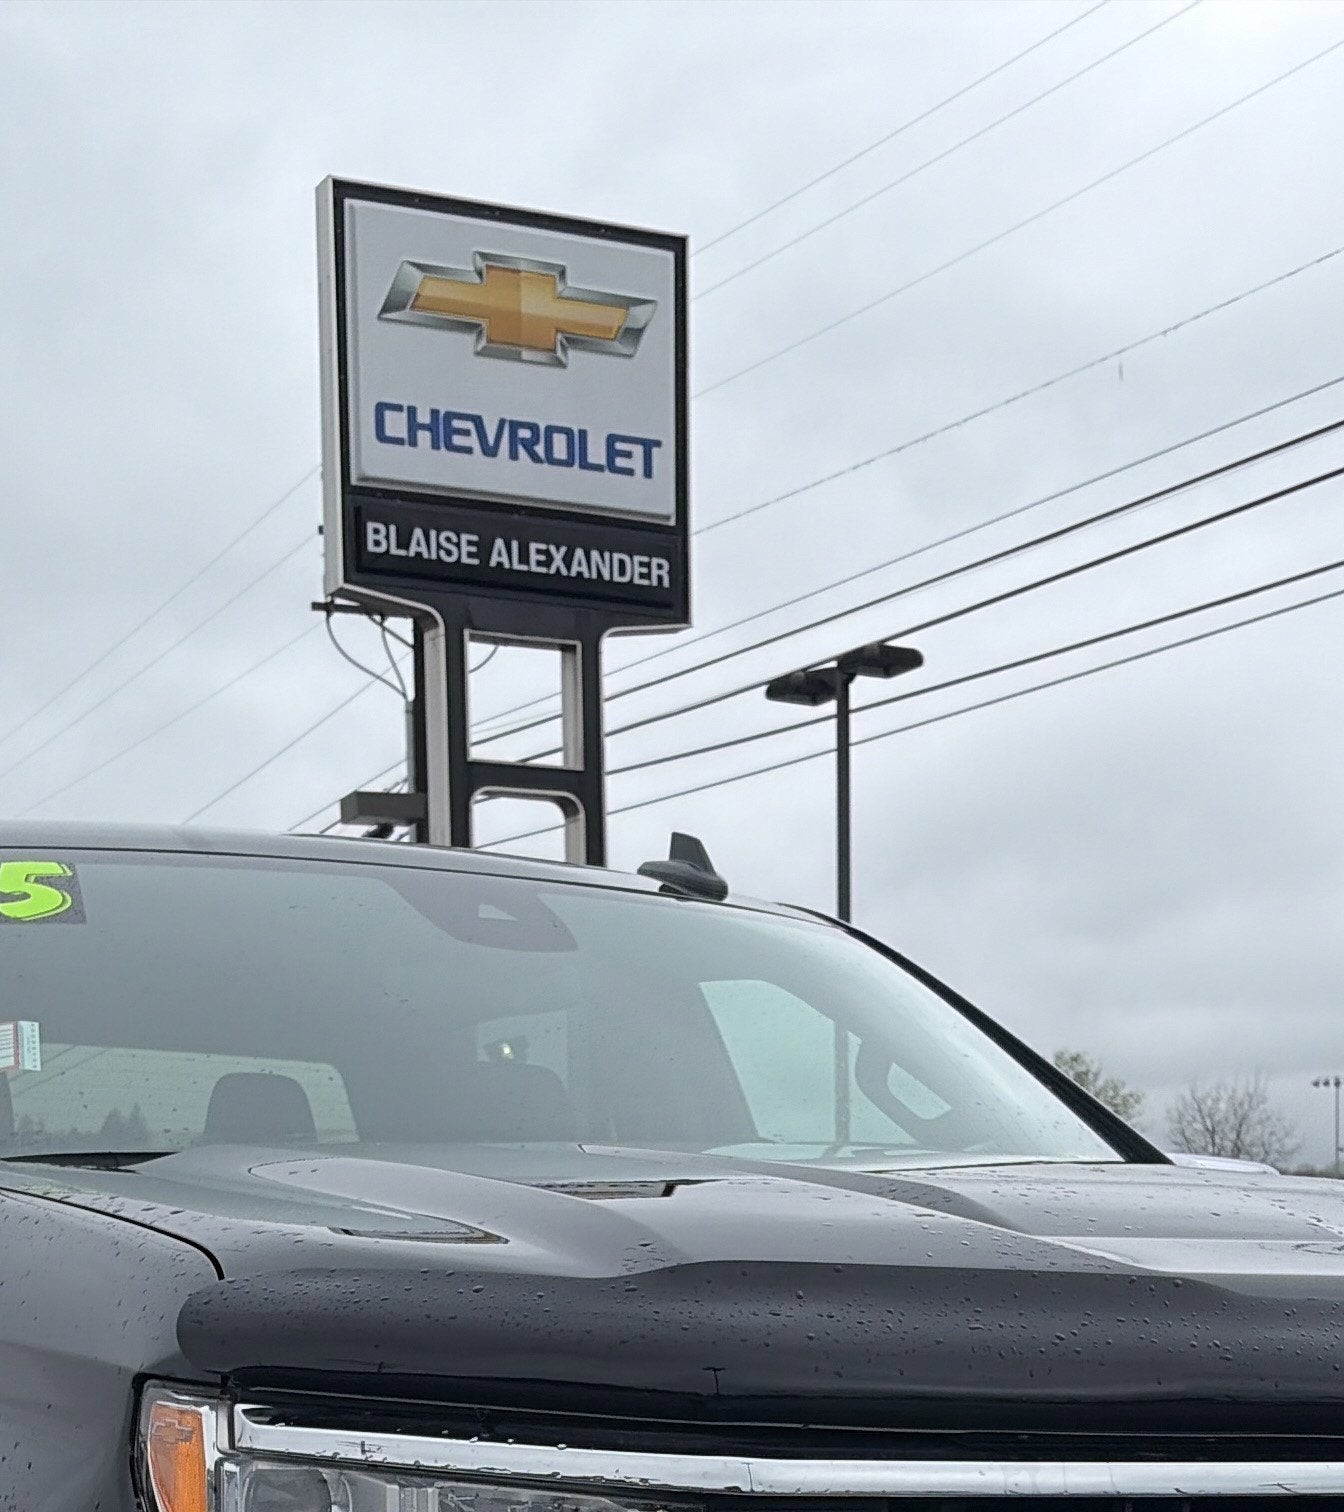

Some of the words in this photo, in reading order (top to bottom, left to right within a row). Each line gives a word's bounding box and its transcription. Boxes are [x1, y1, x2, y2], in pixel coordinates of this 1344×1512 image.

[374, 402, 662, 479] CHEVROLET
[366, 521, 480, 566] BLAISE
[488, 537, 671, 588] ALEXANDER
